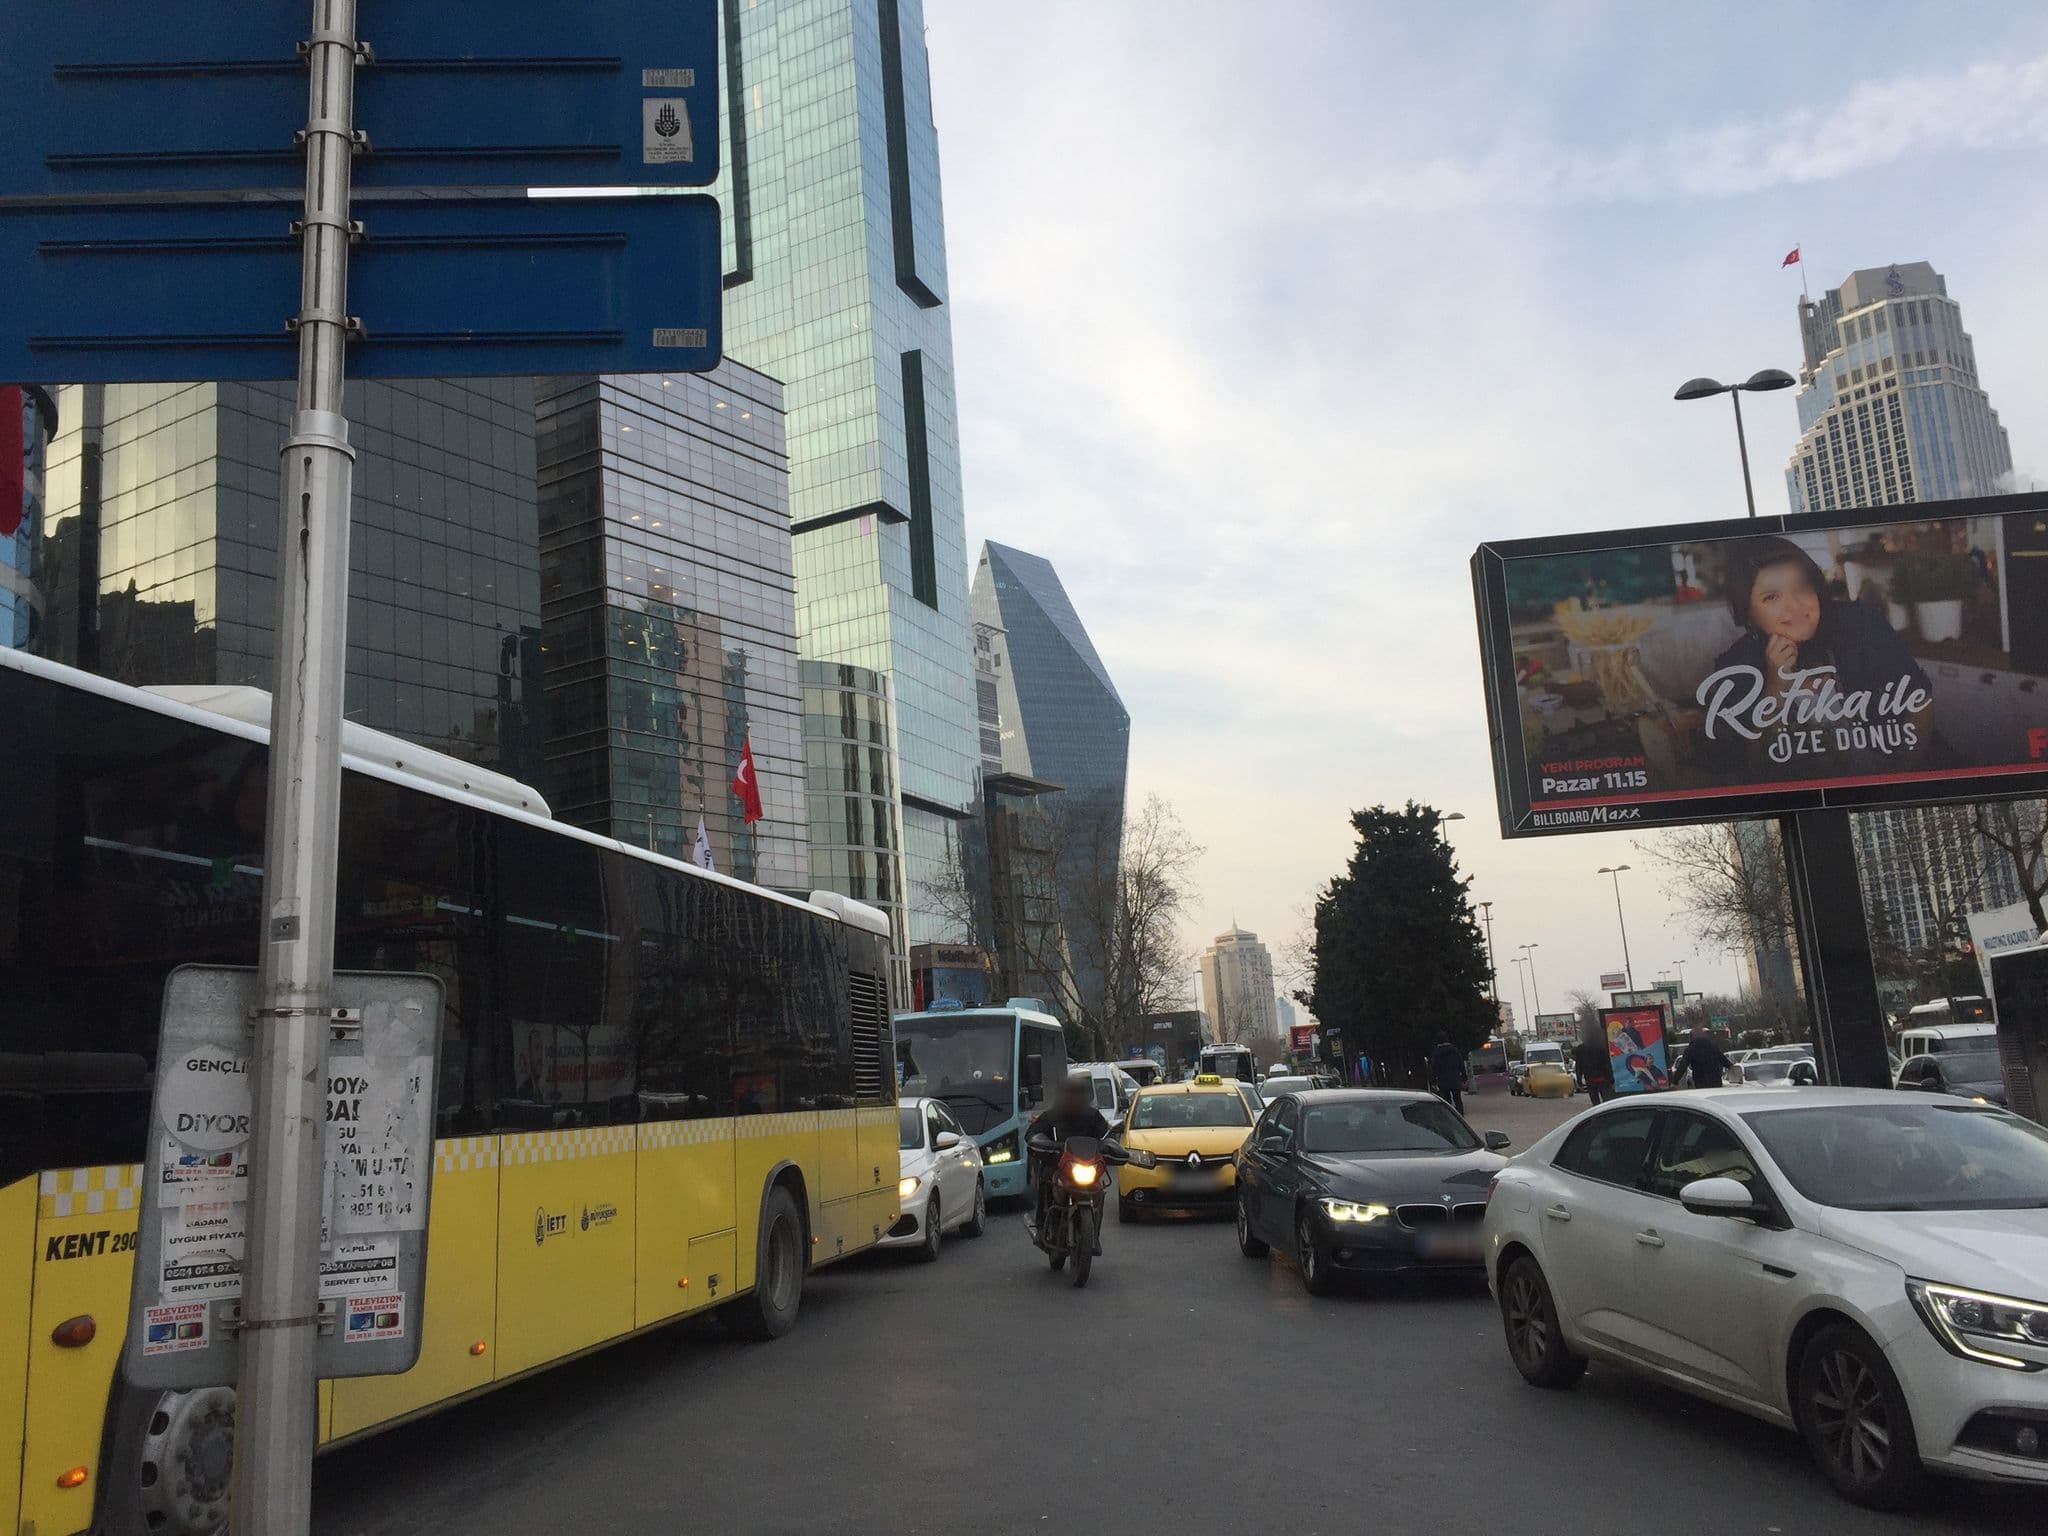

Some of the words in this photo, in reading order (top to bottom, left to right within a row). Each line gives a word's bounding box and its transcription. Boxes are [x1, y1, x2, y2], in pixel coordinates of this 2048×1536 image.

[1878, 675, 1932, 716] ile
[1768, 728, 1826, 763] ÖZE
[1835, 719, 1919, 755] DÖNÜŞ
[1576, 756, 1646, 771] PROGRAM
[1542, 777, 1600, 794] Pazar
[1604, 771, 1648, 789] 11.15
[186, 1059, 249, 1075] GENÇLİ
[186, 1217, 229, 1228] ADANA
[45, 1231, 111, 1262] KENT
[169, 1235, 206, 1245] UYGUN
[171, 1283, 212, 1293] SERVET
[213, 1279, 240, 1289] USTA
[324, 1277, 360, 1287] SERVET
[363, 1275, 388, 1284] USTA
